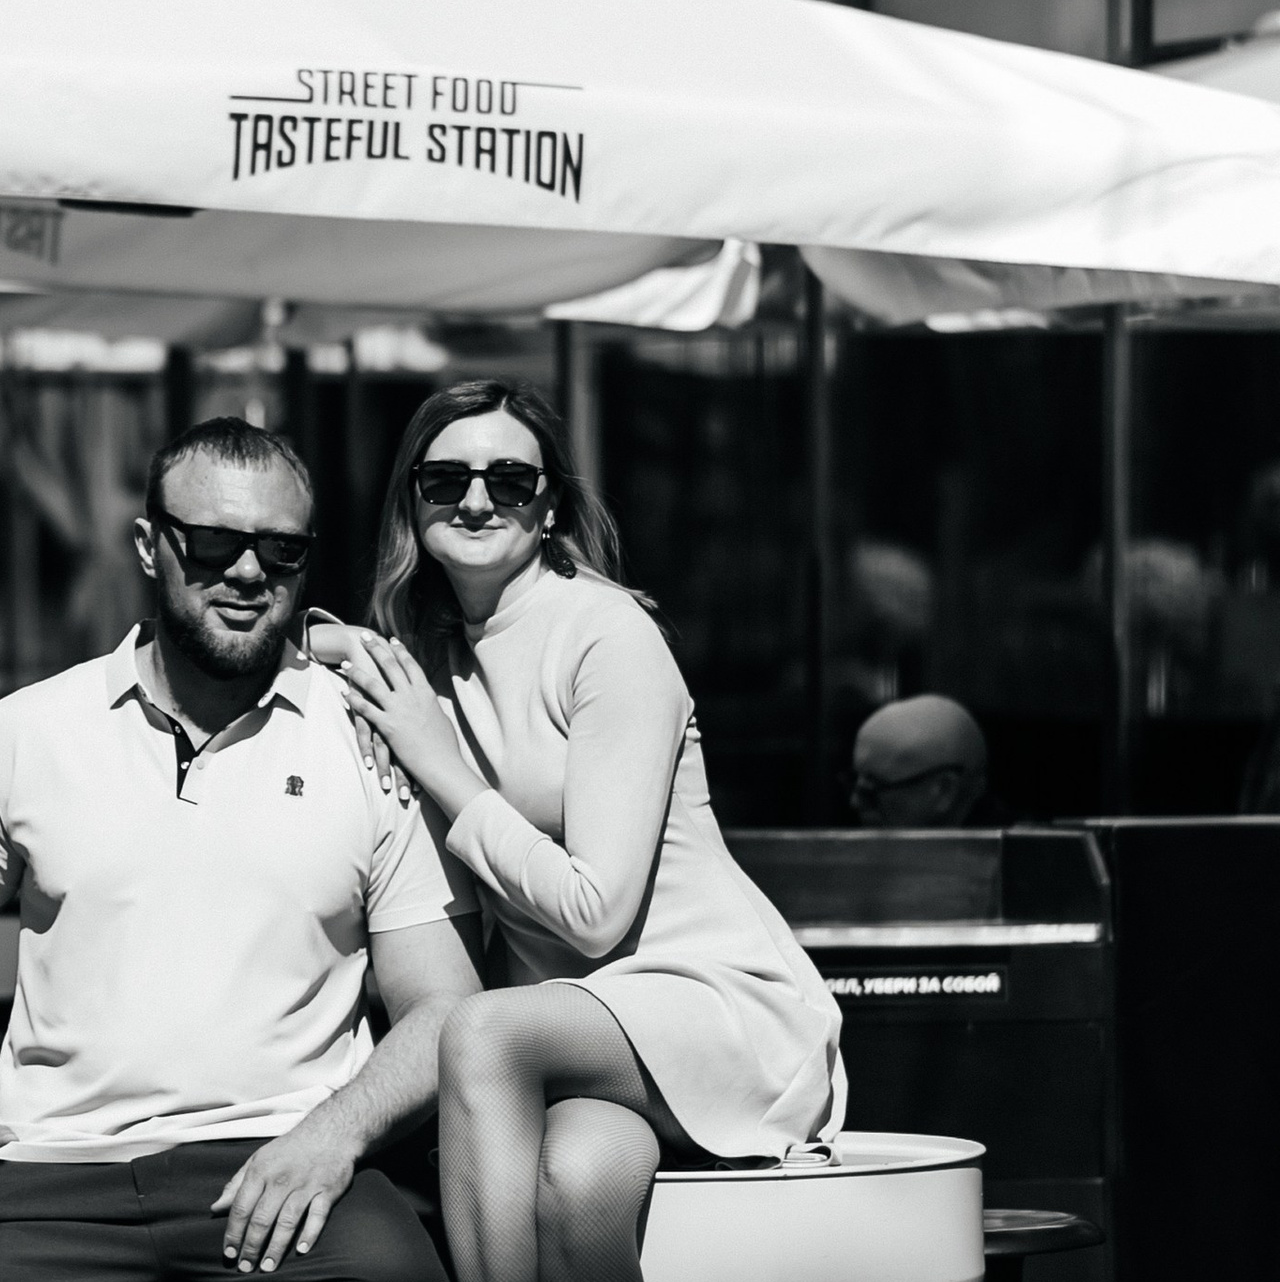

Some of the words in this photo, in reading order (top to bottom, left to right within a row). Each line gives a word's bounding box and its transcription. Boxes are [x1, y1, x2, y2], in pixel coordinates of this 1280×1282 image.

[296, 68, 418, 110] STREET
[431, 75, 518, 116] FOOD
[228, 111, 410, 181] TASTEFUL
[426, 122, 585, 203] STATION
[863, 976, 917, 995] УБЕРИ
[918, 975, 941, 994] ЗА
[942, 972, 1001, 994] СОБОЙ
